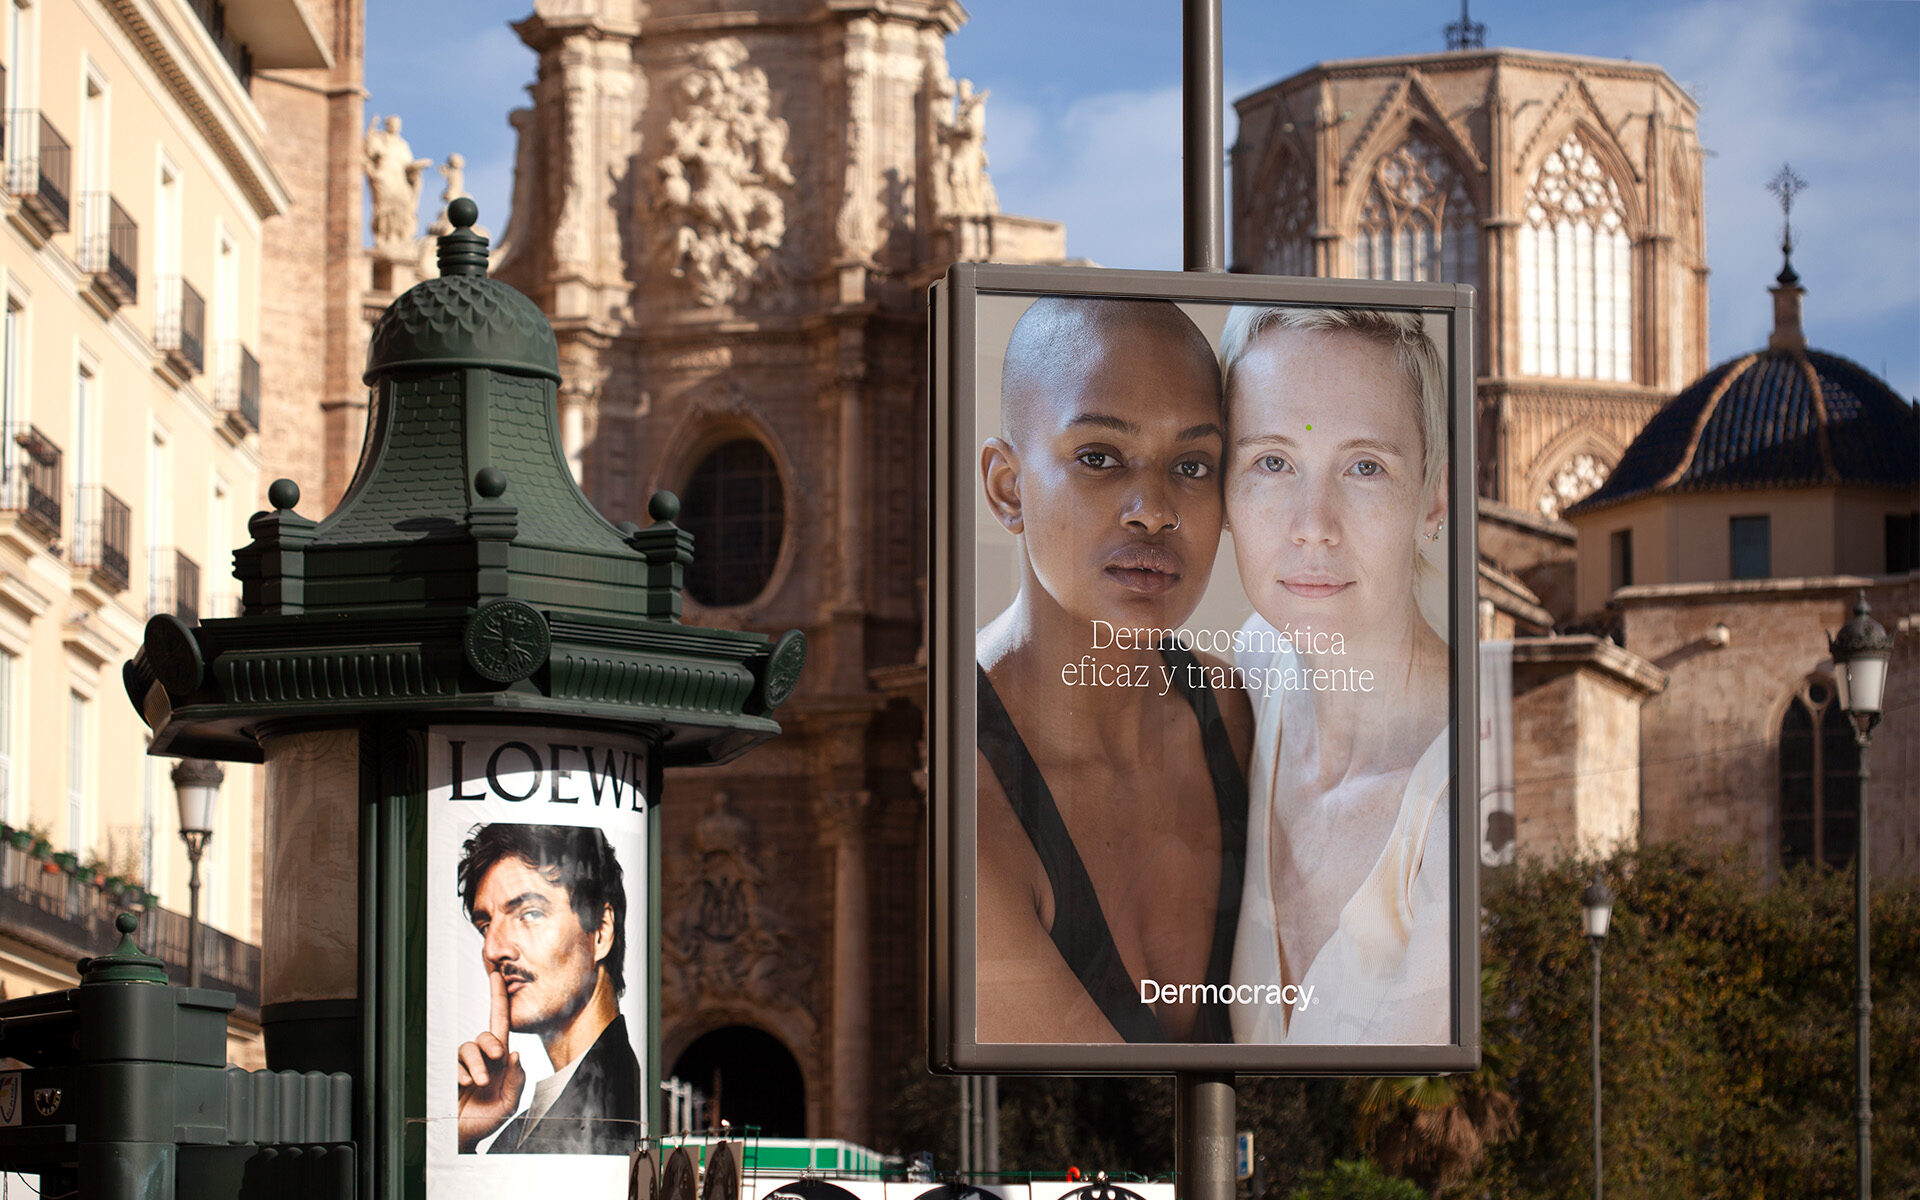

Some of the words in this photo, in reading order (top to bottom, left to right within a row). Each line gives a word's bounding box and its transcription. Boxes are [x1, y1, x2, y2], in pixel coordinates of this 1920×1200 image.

[1090, 619, 1347, 655] Dermocosmética
[1061, 655, 1150, 687] eficaz
[1158, 663, 1177, 696] y
[1186, 661, 1375, 698] transparente
[448, 740, 644, 814] LOEWE
